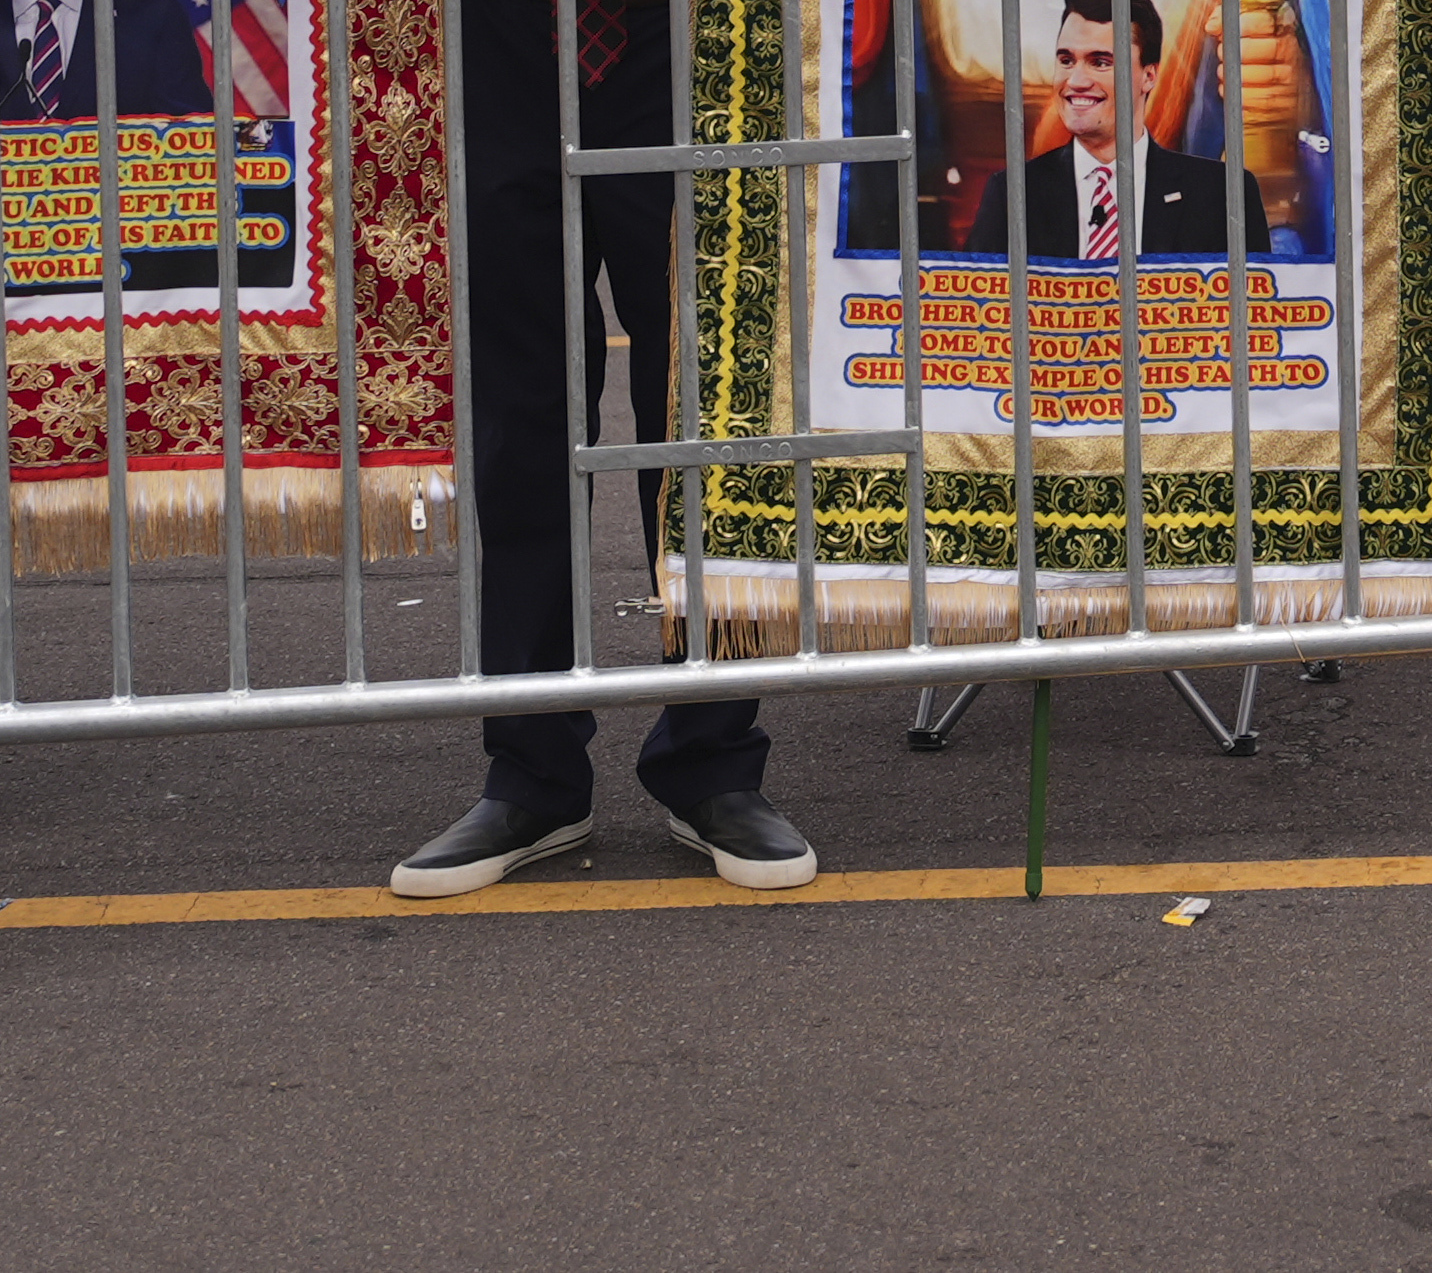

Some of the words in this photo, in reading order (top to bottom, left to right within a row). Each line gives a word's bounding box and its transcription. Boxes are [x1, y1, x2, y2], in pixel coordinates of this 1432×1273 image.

[64, 132, 160, 156] JEUS,
[51, 165, 124, 187] KIR
[31, 197, 93, 218] AND
[119, 194, 170, 213] EFT
[177, 192, 217, 211] TH
[53, 227, 89, 247] OF
[152, 223, 217, 243] FAIT
[244, 222, 280, 241] TO
[934, 275, 1110, 299] EUCHRISTIC
[1115, 276, 1205, 298] ESUS,
[1212, 276, 1270, 294] OR
[850, 302, 977, 323] BROHER
[1103, 307, 1171, 327] KRK
[1177, 304, 1326, 324] RETRNED
[900, 333, 977, 352] OME
[1029, 339, 1078, 359] YOU
[1085, 337, 1142, 357] AN
[1149, 335, 1214, 354] LEFT
[853, 362, 968, 382] SHIING
[976, 365, 1096, 388] EXMPLE
[1104, 368, 1123, 386] O
[1145, 366, 1190, 385] HIS
[1197, 364, 1279, 383] FATH
[1285, 364, 1321, 382] TO
[1066, 397, 1168, 417] WORD.
